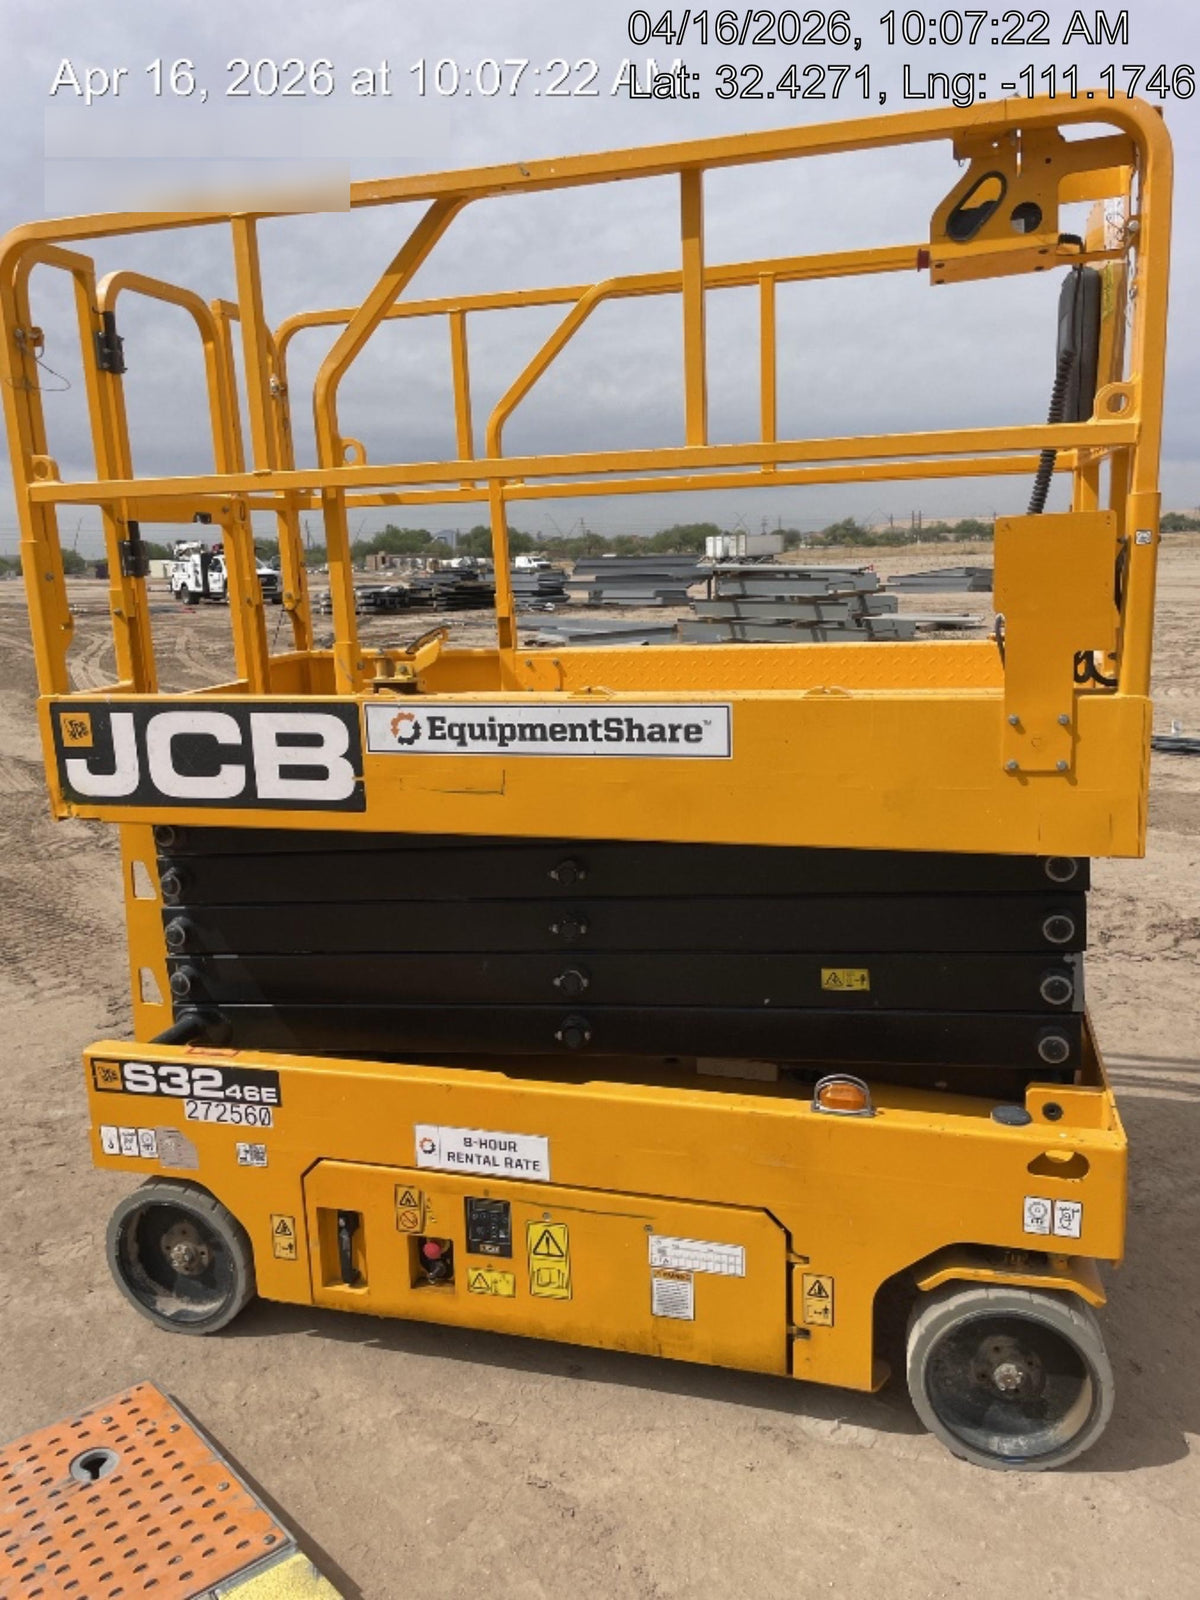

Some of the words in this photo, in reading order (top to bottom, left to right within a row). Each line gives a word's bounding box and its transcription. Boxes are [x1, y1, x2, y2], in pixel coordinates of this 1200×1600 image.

[427, 716, 703, 747] EquipmentShare
[65, 711, 356, 800] JCB
[186, 1100, 271, 1126] 272560
[447, 1151, 500, 1167] RENTAL
[504, 1157, 541, 1172] RATE
